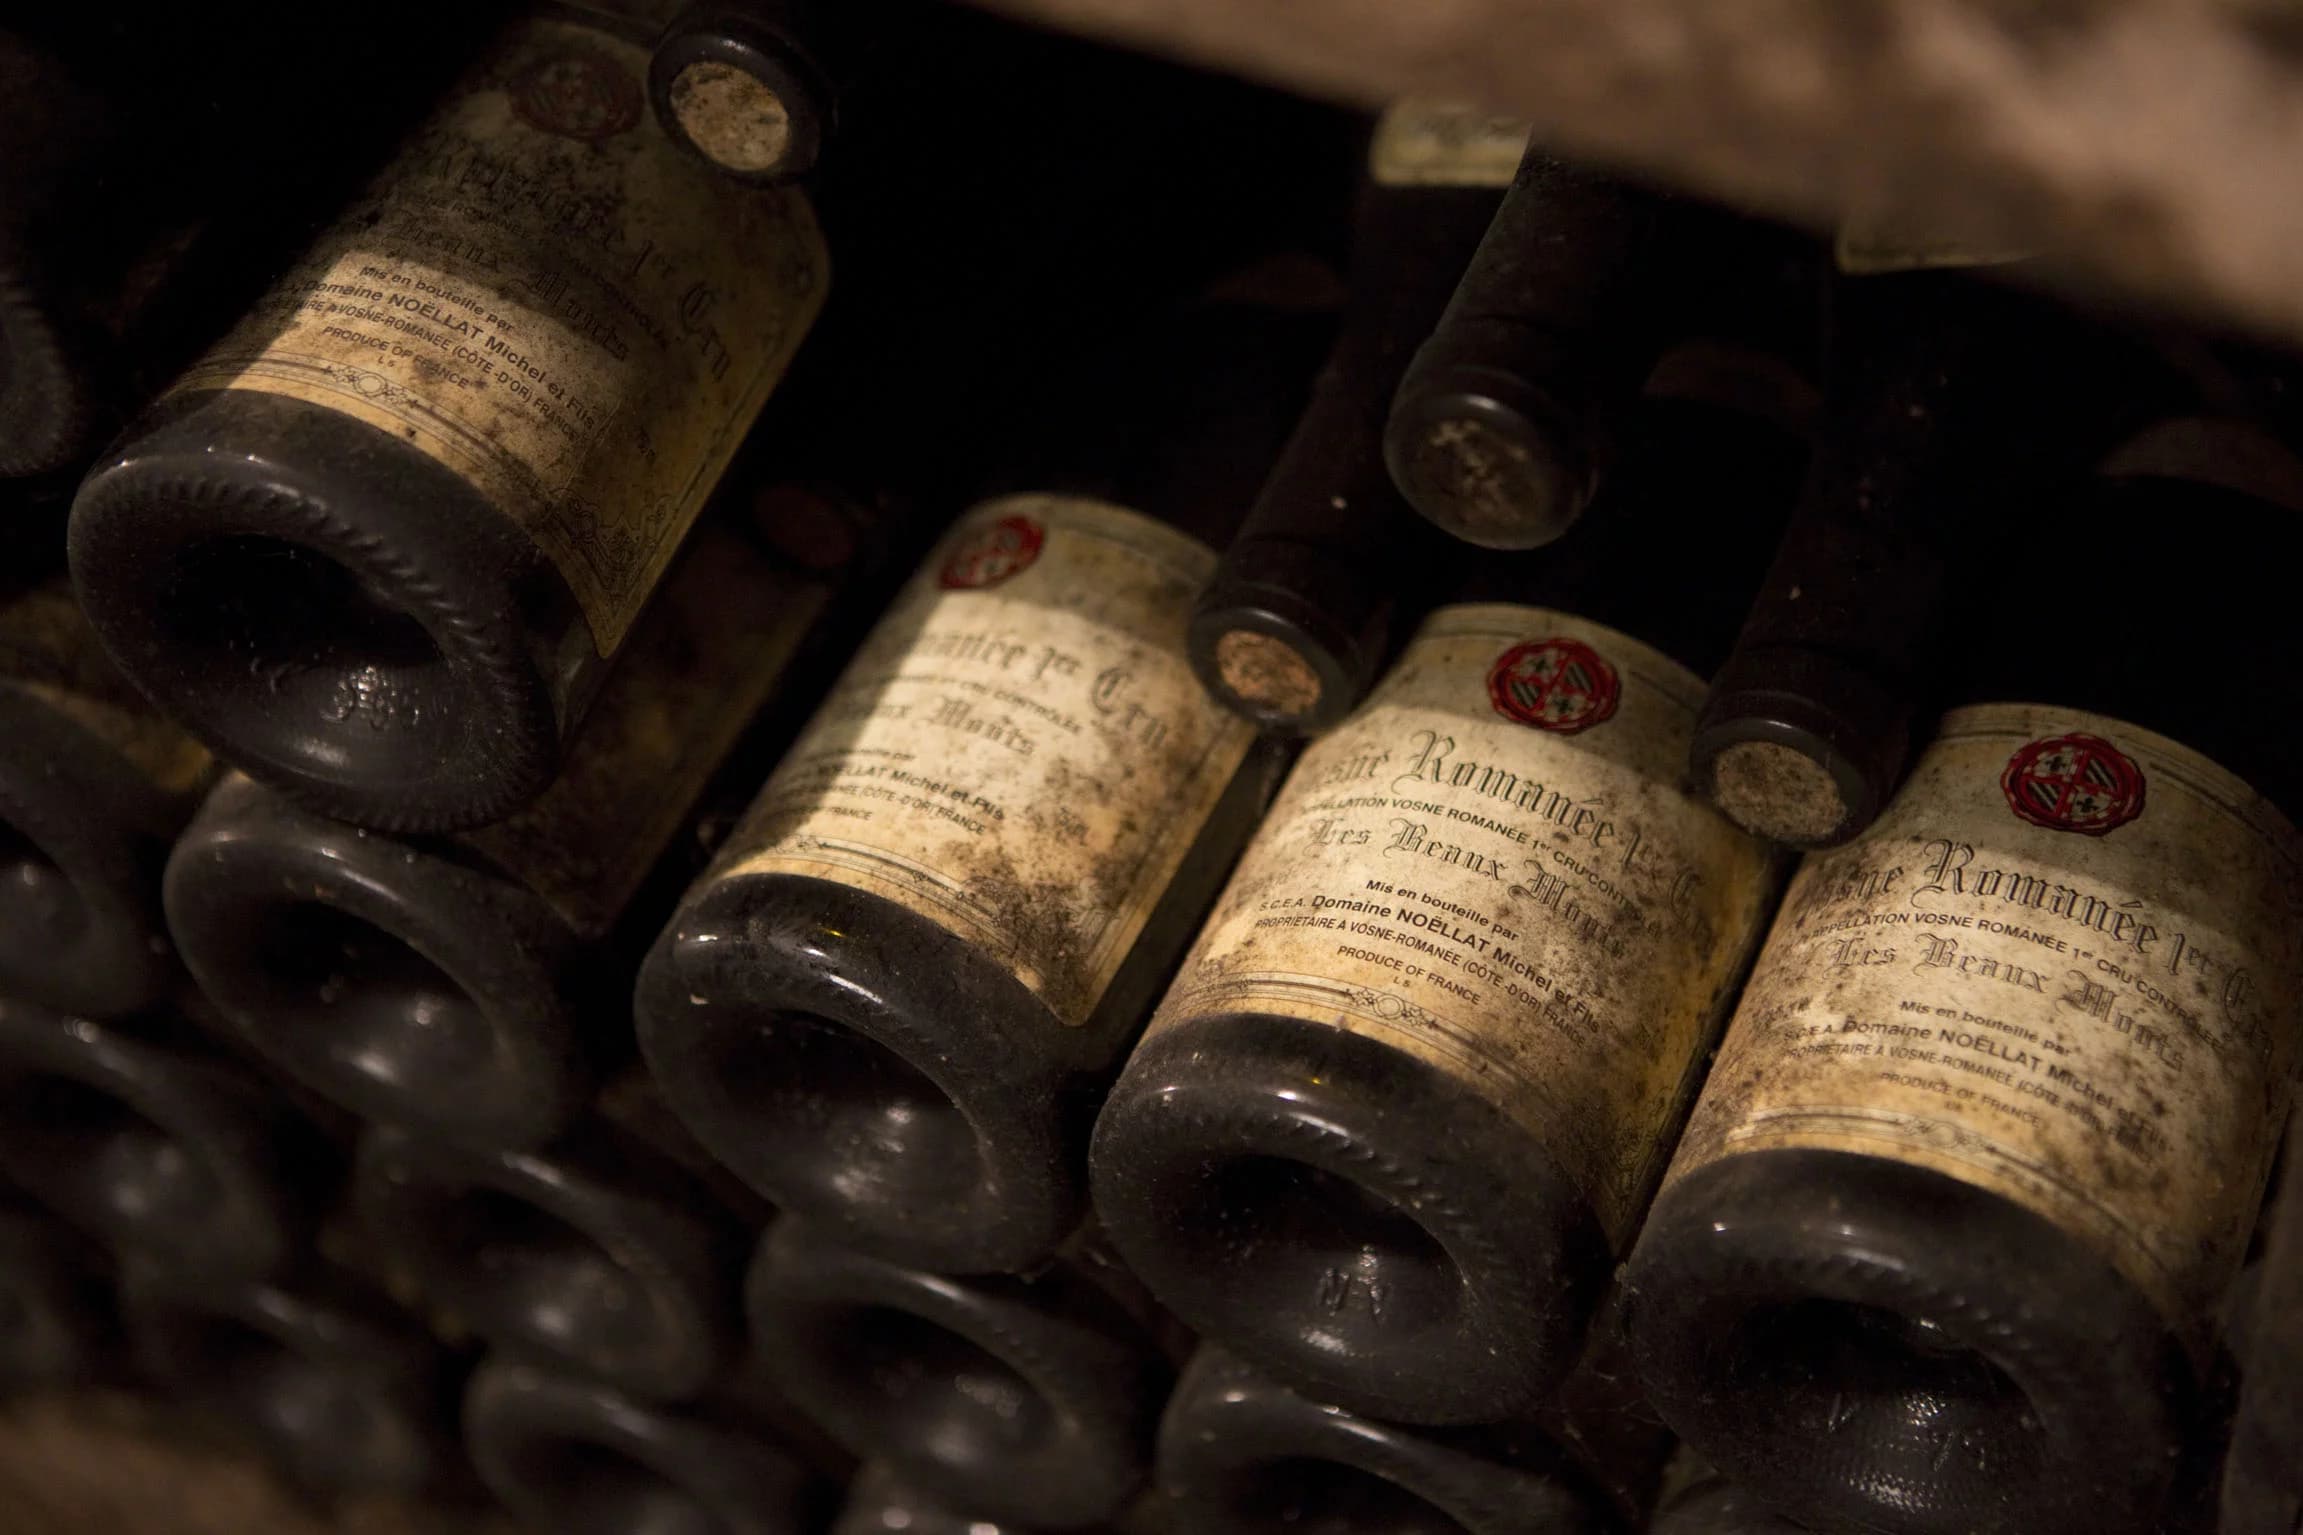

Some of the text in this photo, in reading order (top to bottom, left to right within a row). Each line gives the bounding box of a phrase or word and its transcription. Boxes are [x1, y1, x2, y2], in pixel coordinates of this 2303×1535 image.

[360, 266, 514, 333] Mis en bouteille par
[303, 280, 383, 302] Domaine
[387, 293, 484, 341] NOËLLAT
[484, 336, 547, 384] Michel
[548, 382, 566, 401] et
[322, 326, 391, 351] PRODUCE
[391, 345, 413, 359] OF
[889, 768, 949, 794] Michel
[1391, 729, 1615, 848] Romanée
[1382, 817, 1508, 881] Beaux
[1391, 799, 1444, 816] VOSNE
[1552, 850, 1585, 876] CRU
[1366, 879, 1520, 941] Mis en bouteille par
[1910, 838, 2159, 954] Romanée
[1311, 895, 1392, 918] Domaine
[1396, 908, 1490, 953] NOËLLAT
[1492, 946, 1553, 993] Michel
[1573, 1000, 1600, 1034] Fils
[1337, 945, 1482, 1006] PRODUCE OF FRANCE
[1912, 932, 2052, 994] Beaux
[1914, 912, 1974, 928] VOSNE
[2096, 958, 2133, 985] CRU
[1462, 958, 1505, 988] (CÔTE
[1543, 1006, 1587, 1049] FRANCE
[1901, 1000, 1931, 1015] Mis
[1934, 1006, 1958, 1019] en
[1961, 1011, 2039, 1043] bouteille
[1844, 1018, 1932, 1040] Domaine
[2047, 1064, 2114, 1110] Michel
[1879, 1072, 1951, 1096] PRODUCE
